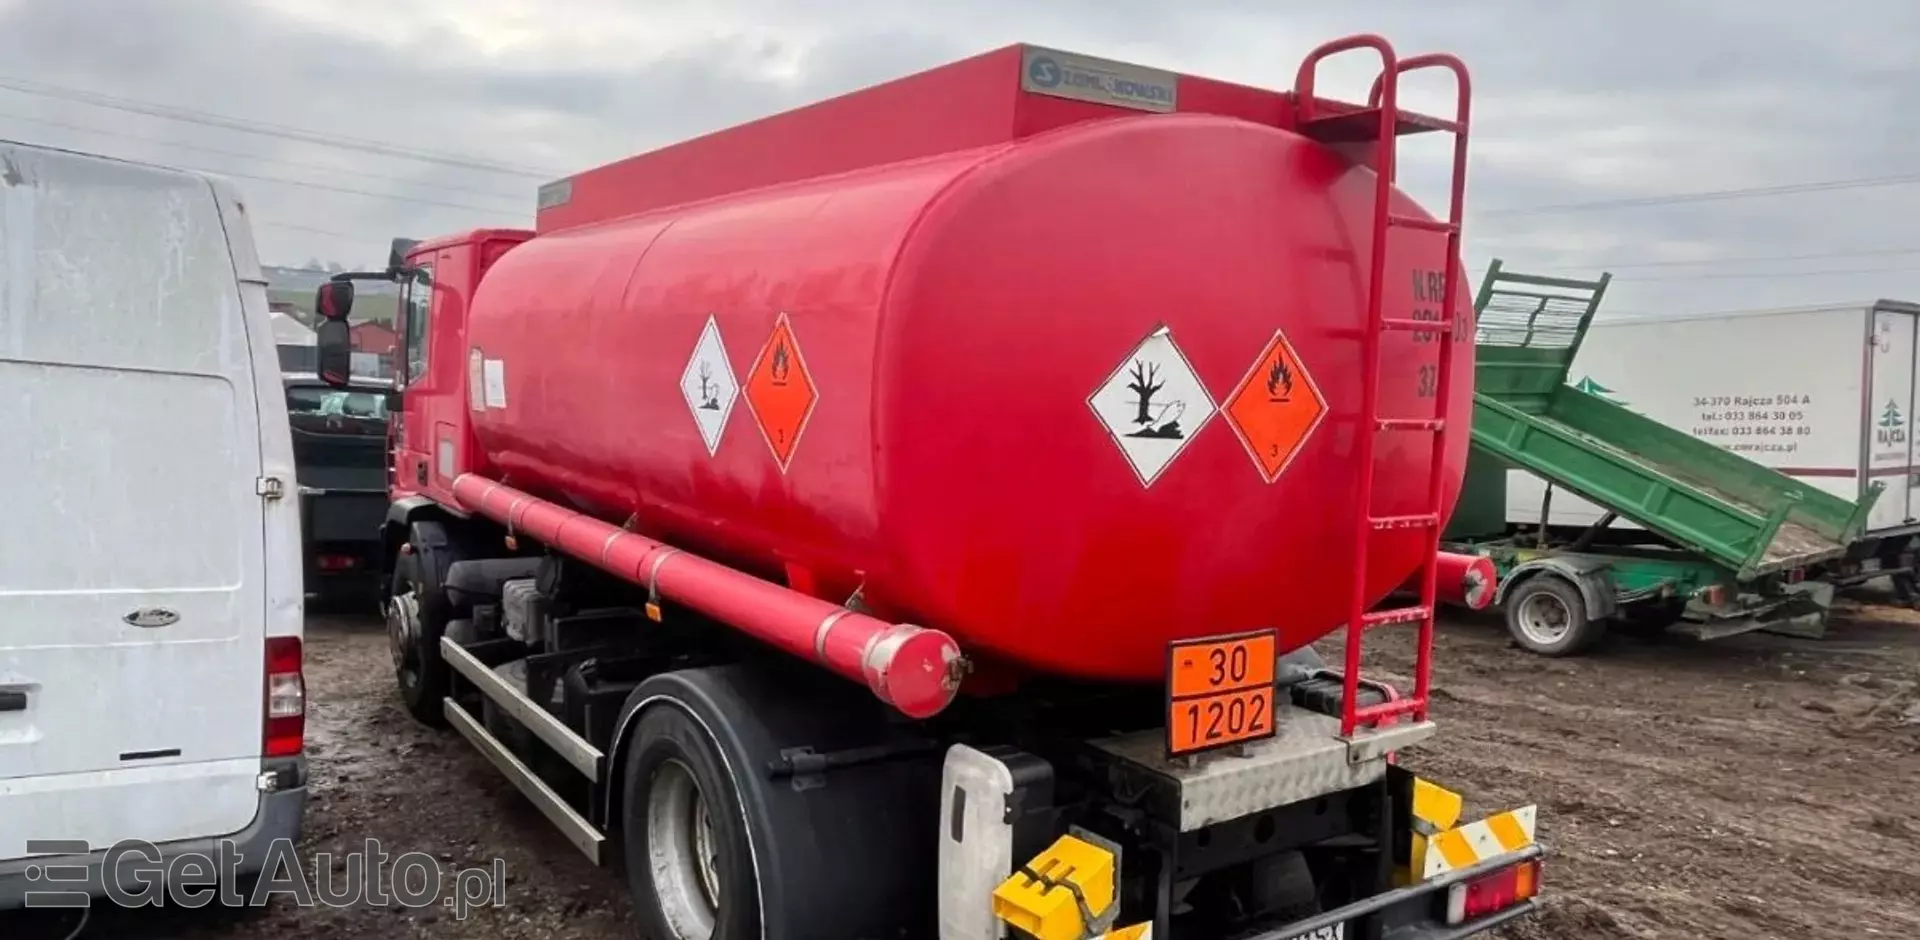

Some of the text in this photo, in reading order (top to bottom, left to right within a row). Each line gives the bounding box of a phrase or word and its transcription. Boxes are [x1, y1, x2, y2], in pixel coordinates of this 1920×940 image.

[1693, 396, 1731, 406] 34-370
[1734, 396, 1773, 407] Rajcza
[1802, 394, 1811, 404] A
[1724, 411, 1745, 420] 033
[1269, 443, 1279, 458] 3
[1208, 644, 1248, 686] 30
[1187, 693, 1265, 745] 1202
